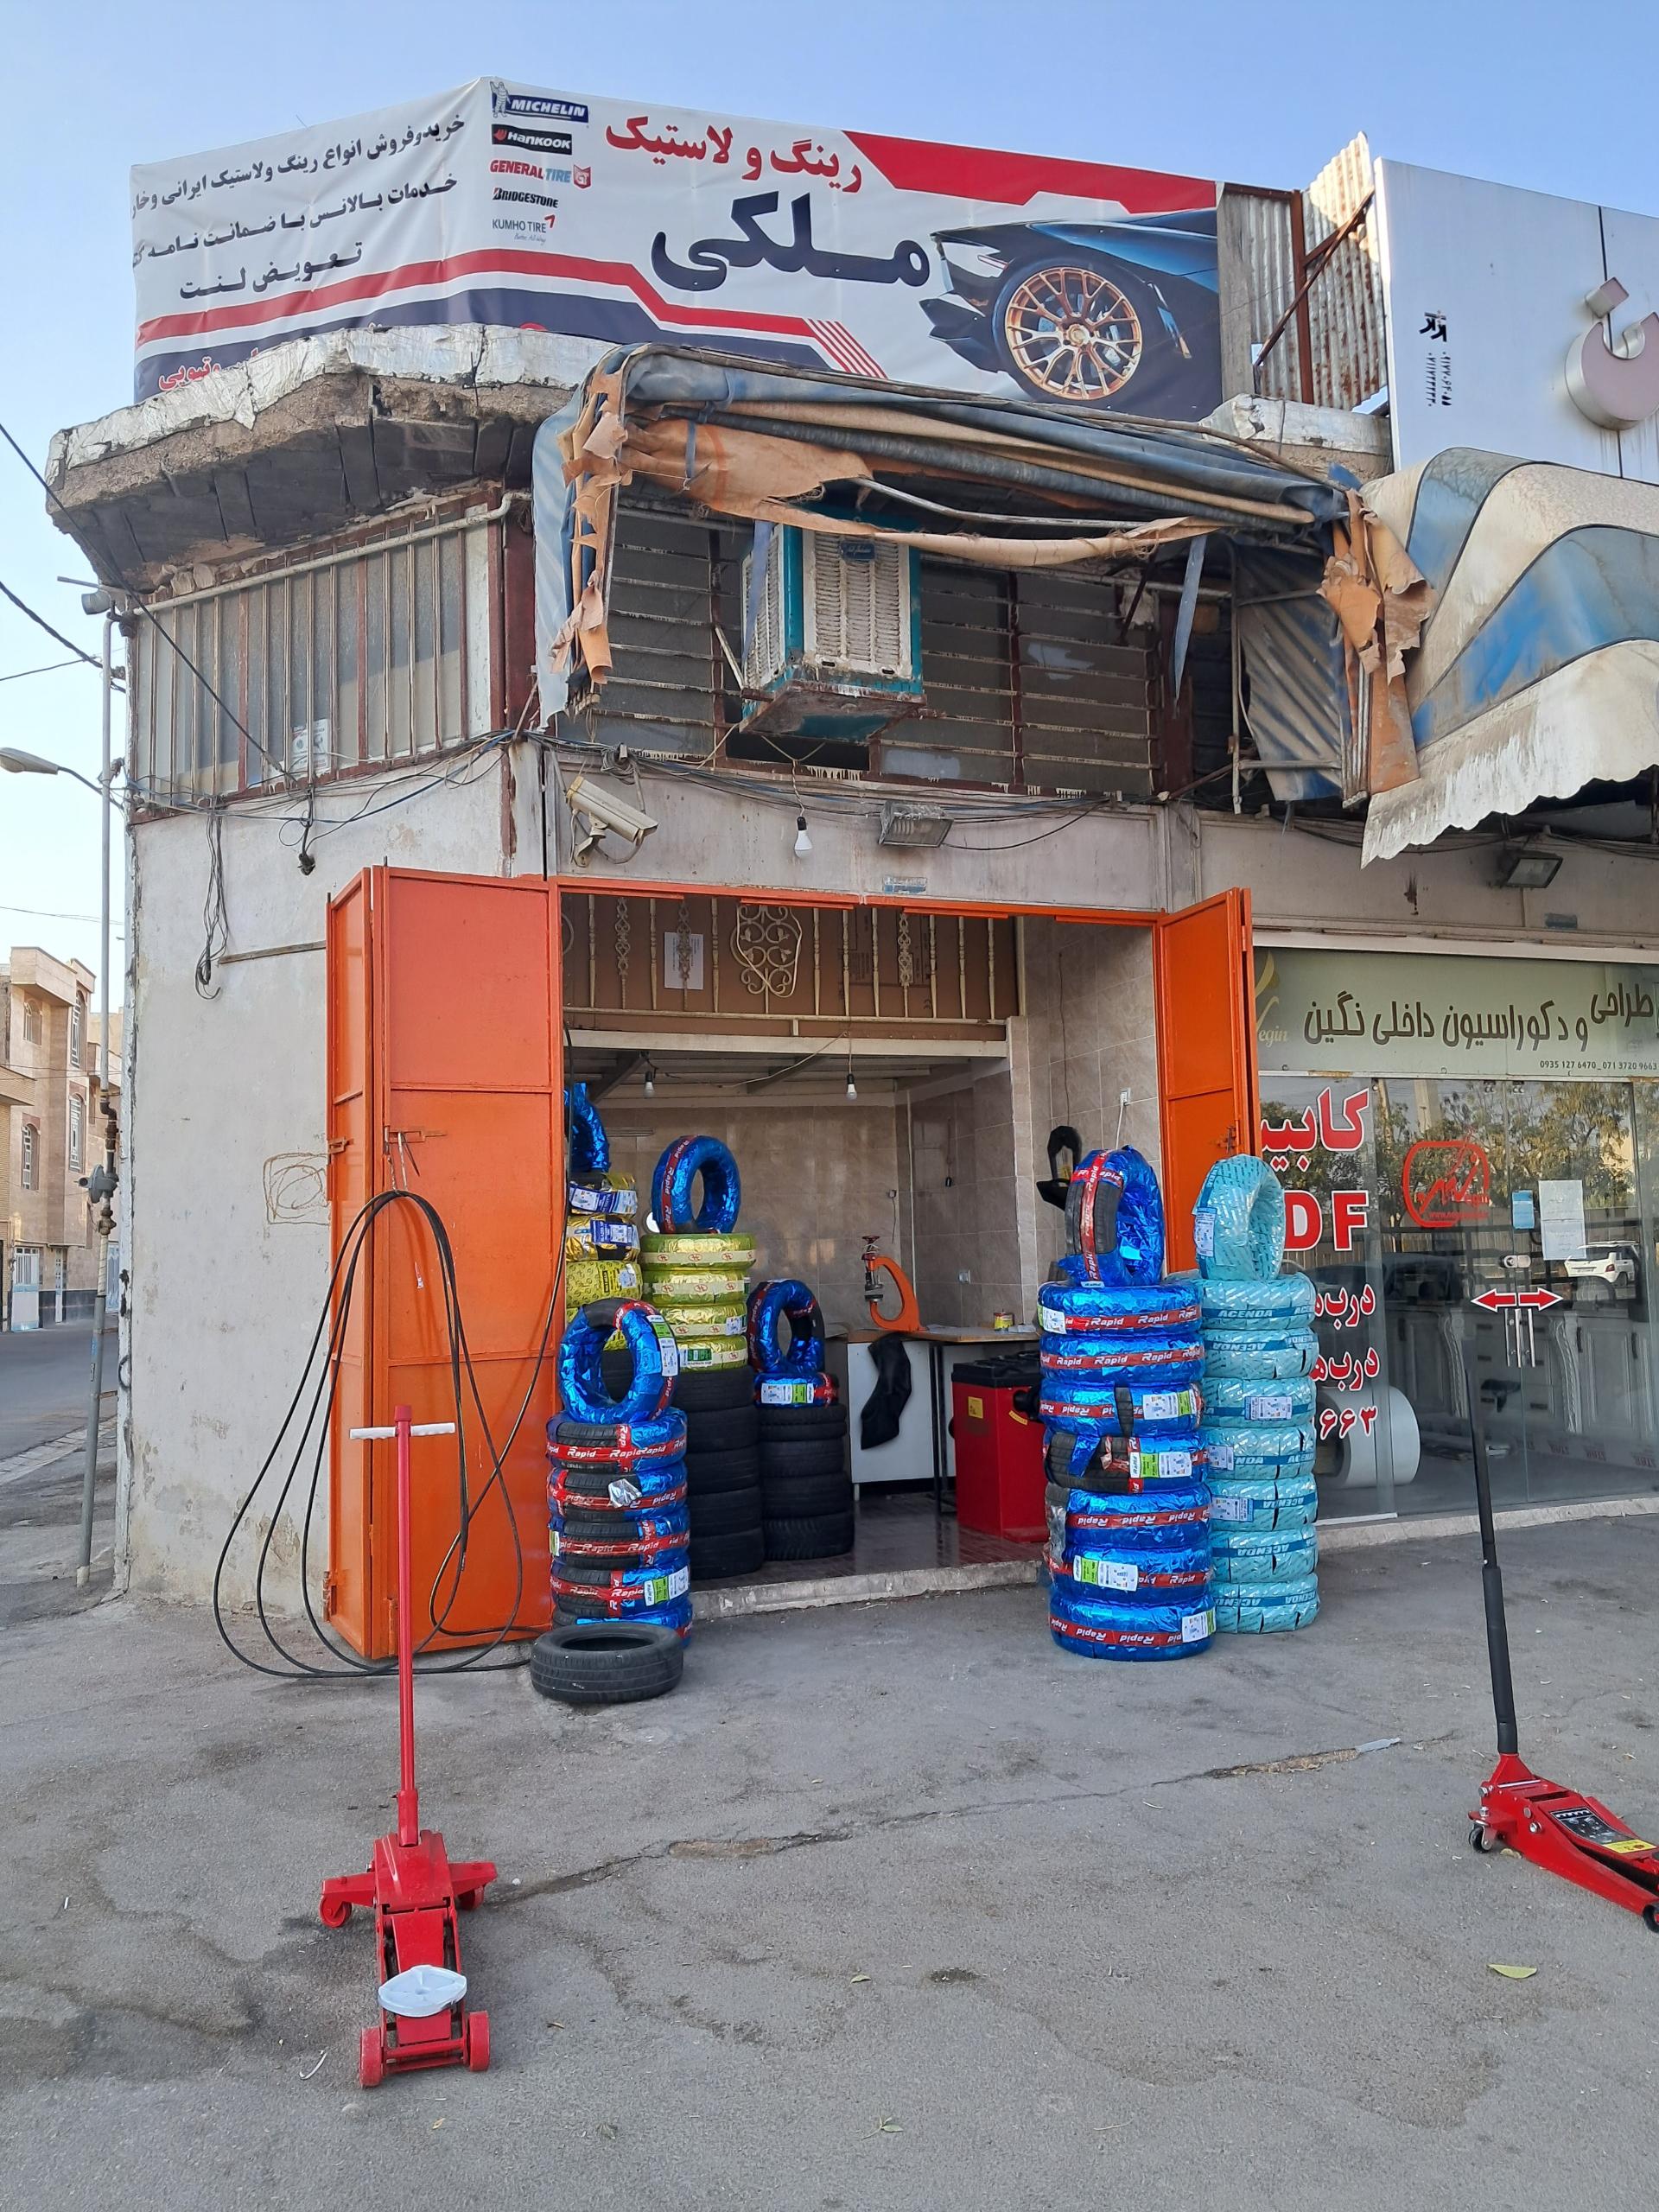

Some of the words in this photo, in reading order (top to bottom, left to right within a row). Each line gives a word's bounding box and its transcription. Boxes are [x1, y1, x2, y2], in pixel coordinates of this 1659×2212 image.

[511, 99, 586, 118] MICHELIN
[322, 138, 362, 169] انواع
[605, 116, 734, 166] لاستیک
[277, 154, 318, 173] رینگ
[490, 159, 544, 180] GENERAL
[545, 168, 571, 183] TIRE
[741, 145, 763, 181] و
[769, 138, 862, 194] رینگ
[162, 175, 207, 206] ایرانی
[387, 173, 458, 205] خدمات
[492, 187, 559, 209] BRIDGESTONE
[280, 212, 306, 232] با
[309, 192, 383, 228] بالانس
[203, 215, 276, 248] ضمانت
[492, 218, 526, 232] KUMHO
[528, 220, 547, 233] TIRE
[147, 232, 199, 258] نامه
[651, 190, 931, 292] ملکی
[252, 242, 363, 293] تعویض
[179, 265, 246, 300] لنت
[1590, 982, 1655, 1027] طراحی
[1304, 990, 1365, 1045] نگین
[1372, 1001, 1435, 1046] داخلی
[1539, 1060, 1560, 1070] 0935
[1561, 1060, 1575, 1070] 127
[1618, 1061, 1637, 1071] 3720
[1086, 1165, 1098, 1192] Rapid
[1284, 1190, 1370, 1252] DF
[1086, 1251, 1098, 1280] Rapi
[1090, 1317, 1124, 1327] Rapid
[1137, 1313, 1169, 1325] Rapid
[1218, 1309, 1273, 1318] ACENDA
[1294, 1306, 1313, 1315] ACE
[1056, 1357, 1082, 1367] Rapid
[1094, 1356, 1128, 1367] Rapid
[1141, 1351, 1173, 1363] Rapid
[1062, 1406, 1090, 1415] Rapid
[1319, 1405, 1378, 1440] ۶۶۳
[618, 1425, 629, 1448] Rap
[567, 1446, 597, 1459] Rapid
[652, 1491, 677, 1503] Rapid
[1077, 1517, 1109, 1527] Rapid
[1122, 1516, 1156, 1526] Rapid
[1168, 1511, 1196, 1522] Rapid
[582, 1543, 615, 1554] Rapid
[627, 1541, 659, 1552] Rapid
[1236, 1543, 1290, 1556] ACENDA
[1169, 1574, 1196, 1585] Rapid
[1076, 1628, 1107, 1642] Rapid
[1119, 1634, 1154, 1644] Rapid
[1166, 1633, 1181, 1643] pid
